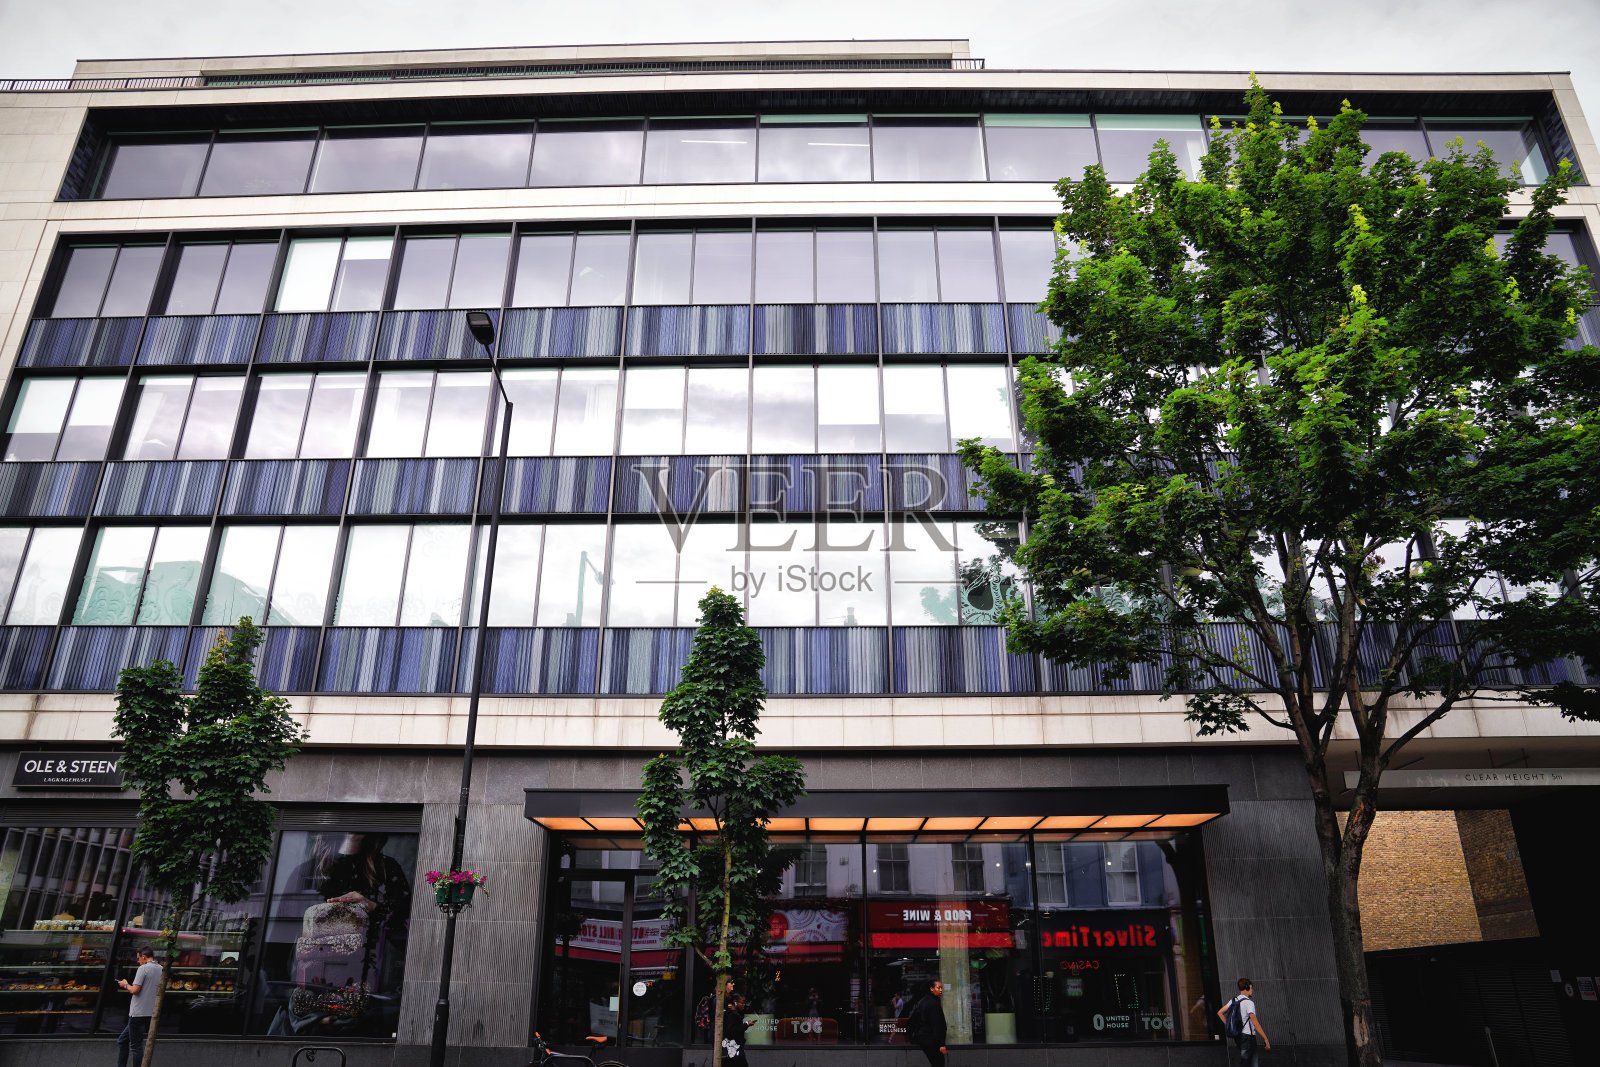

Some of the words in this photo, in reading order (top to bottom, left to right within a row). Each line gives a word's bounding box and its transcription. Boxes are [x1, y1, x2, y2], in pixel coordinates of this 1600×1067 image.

[24, 760, 54, 773] OLE
[56, 760, 67, 773] &
[70, 760, 118, 773] STEEN
[1464, 773, 1498, 782] CLEAR
[1505, 773, 1545, 781] HEIGHT
[791, 1020, 823, 1034] TOG
[1141, 1016, 1174, 1030] TOG
